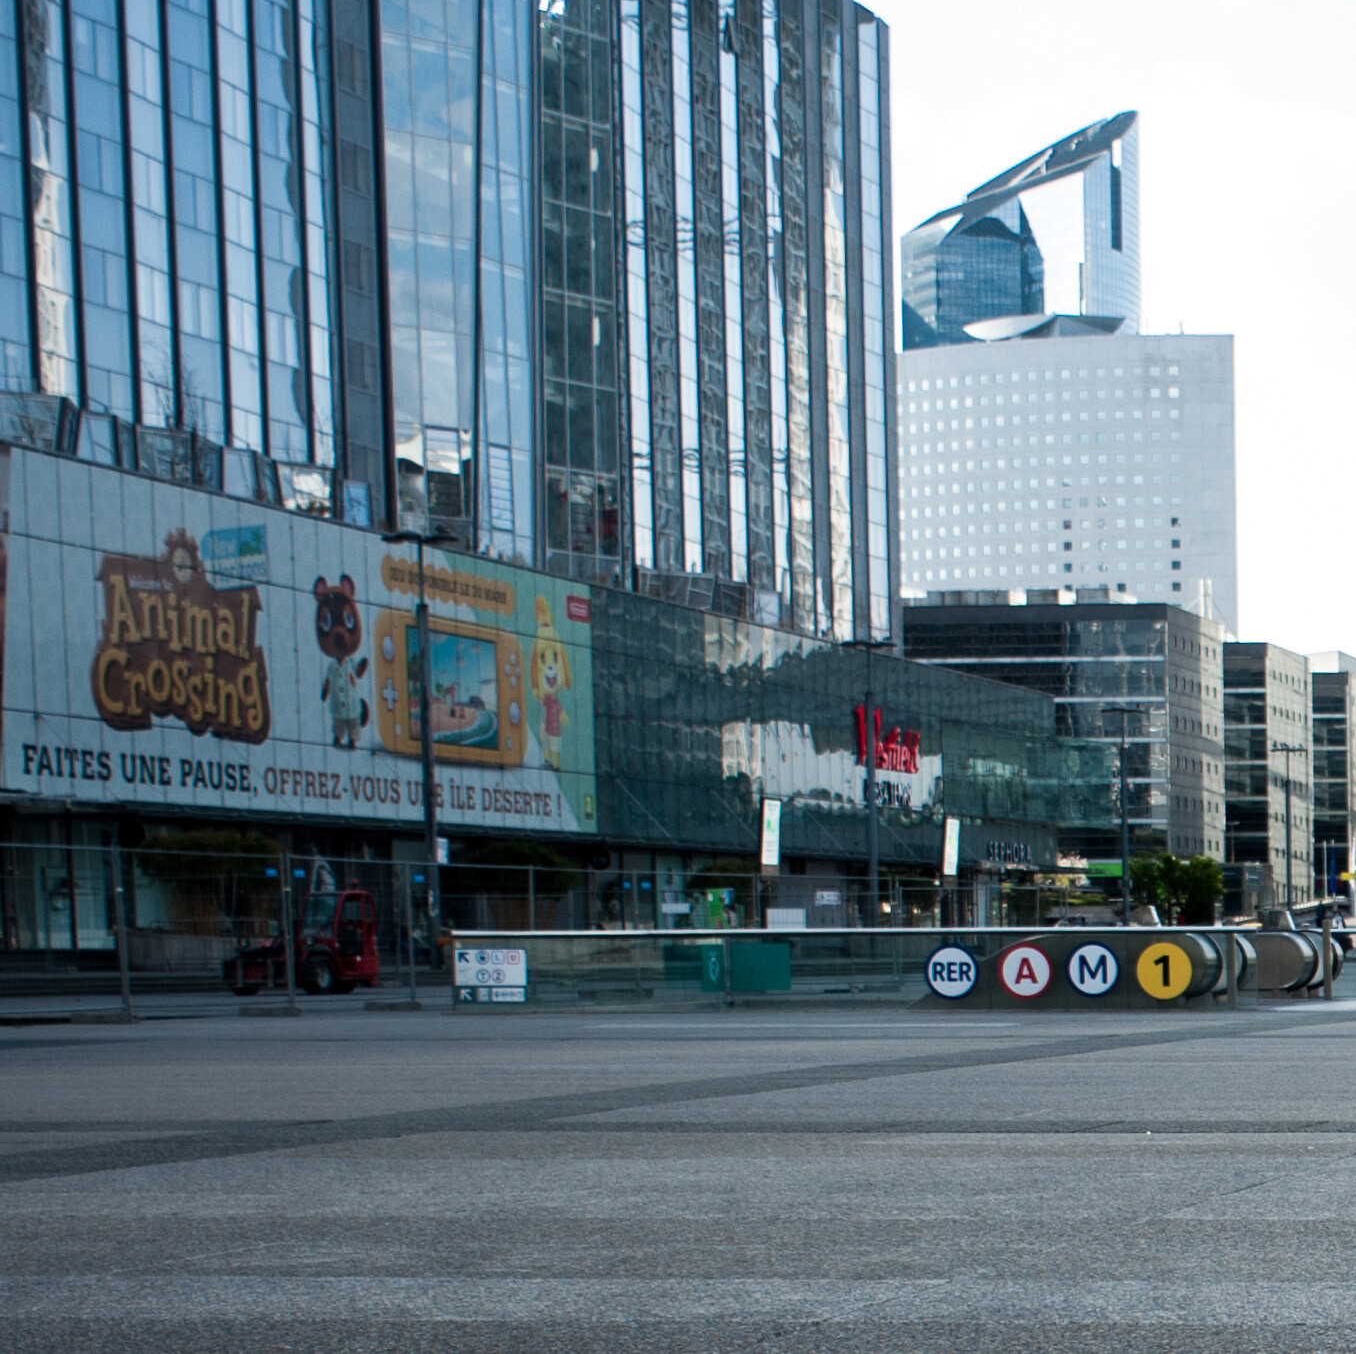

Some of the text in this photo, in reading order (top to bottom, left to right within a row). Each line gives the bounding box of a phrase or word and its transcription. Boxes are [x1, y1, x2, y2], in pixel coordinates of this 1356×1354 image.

[108, 573, 250, 661] Animal
[98, 647, 263, 732] Crossing
[22, 743, 112, 782] FAITES
[120, 753, 172, 786] UNE
[180, 758, 258, 798] PAUSE,
[264, 766, 402, 806] OFFREZ-VOUS
[408, 780, 444, 809] UE
[450, 778, 476, 811] ÎLE
[482, 782, 553, 818] DÉSERTE
[988, 840, 1033, 864] SEPHORA
[931, 954, 1171, 987] RER A M 1
